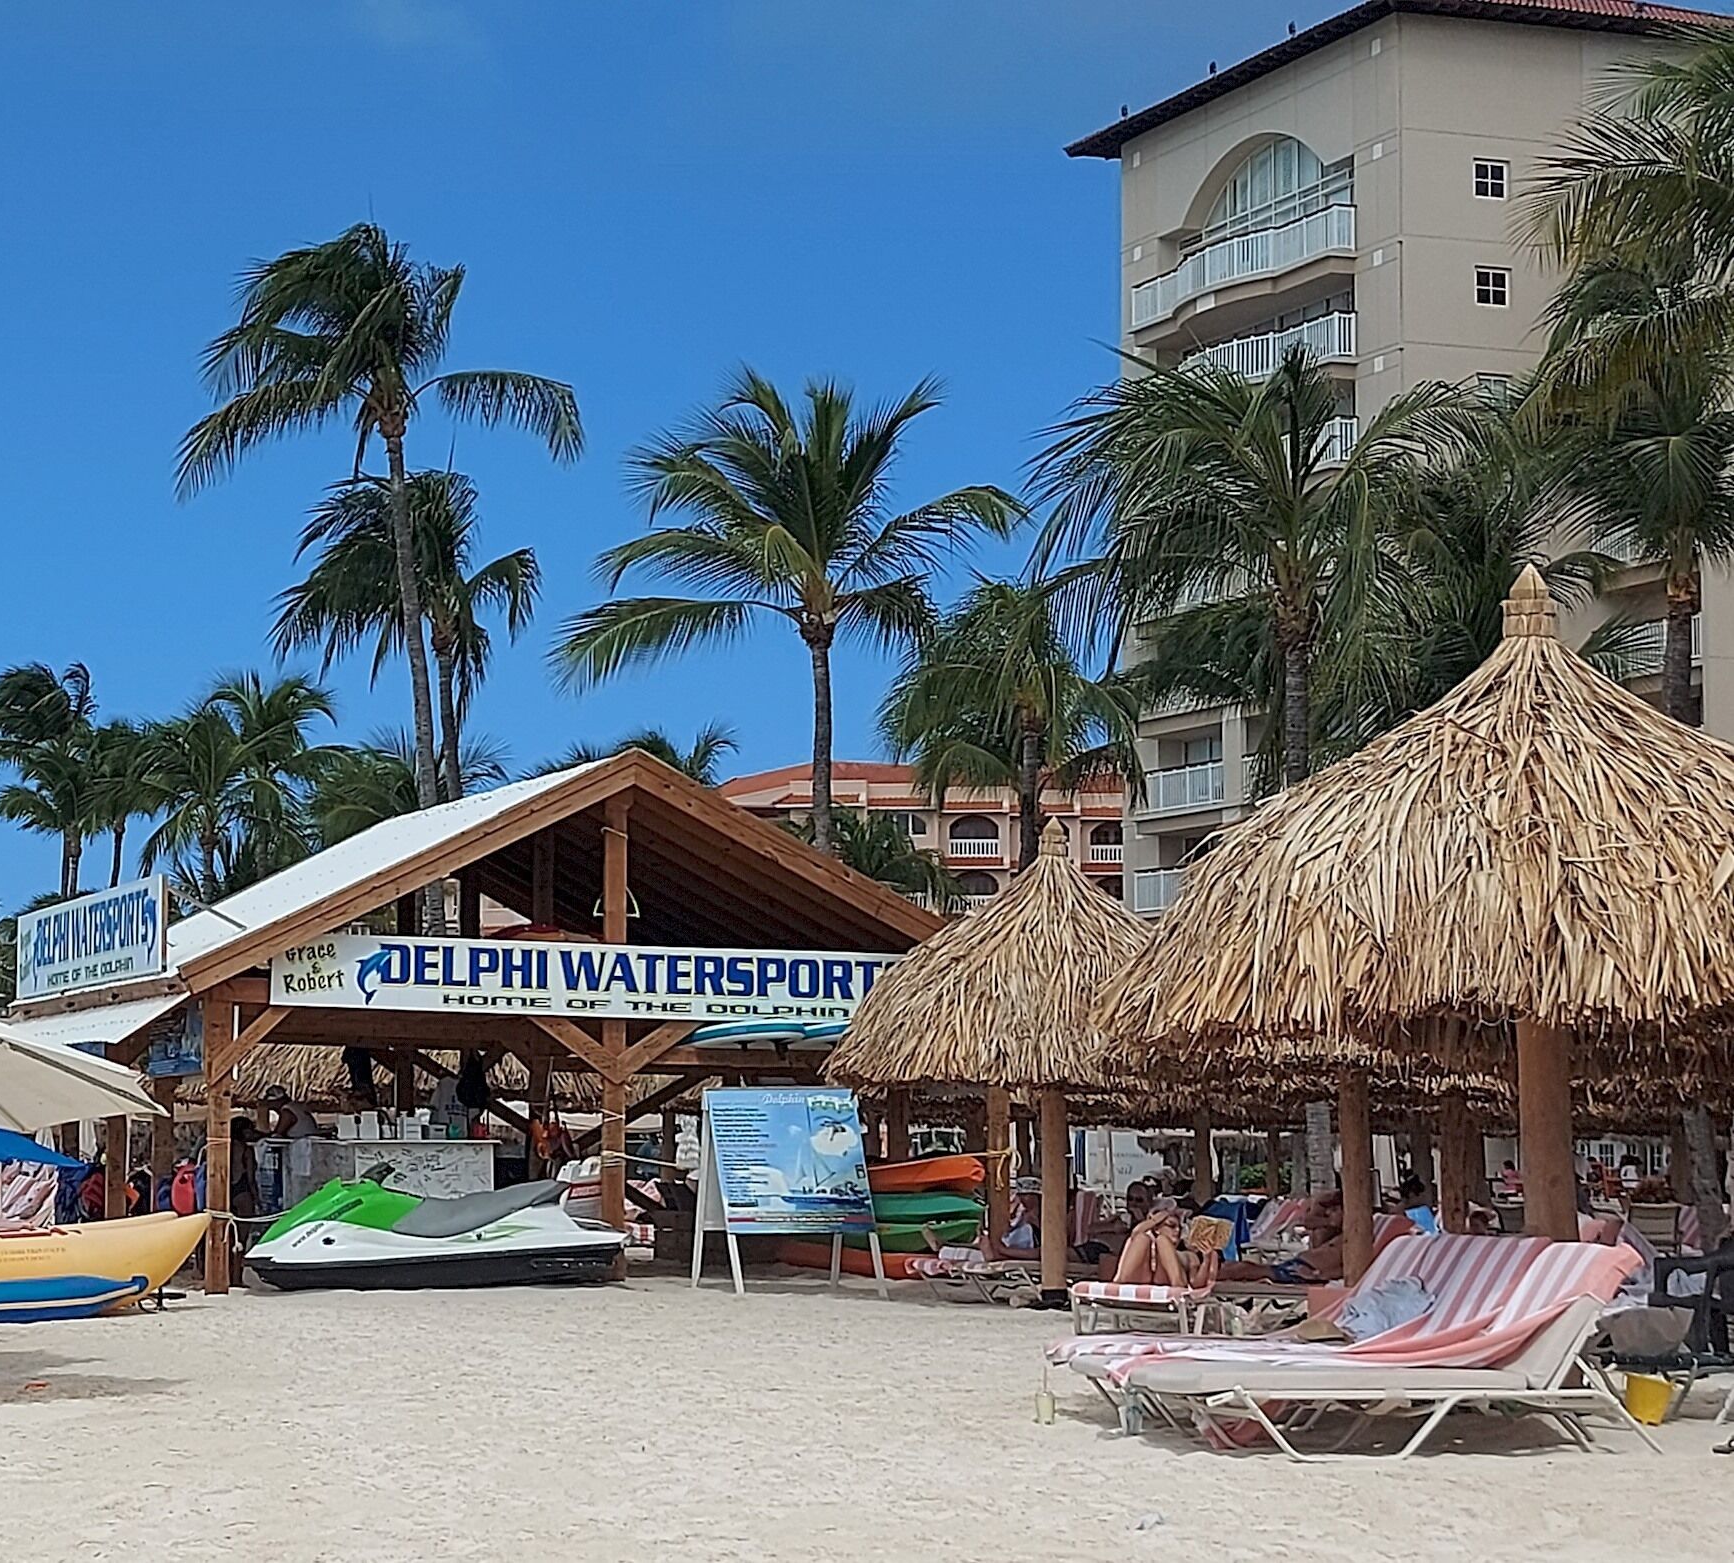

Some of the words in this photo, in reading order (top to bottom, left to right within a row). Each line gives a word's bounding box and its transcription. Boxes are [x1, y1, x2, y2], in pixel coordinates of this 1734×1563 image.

[36, 911, 69, 967] DELPHI
[72, 888, 149, 960] WATERSPORTS
[285, 943, 336, 962] Grace
[47, 971, 69, 987] HOME
[72, 968, 82, 981] OF
[85, 964, 98, 979] THE
[101, 957, 134, 978] DOLPHIN
[283, 969, 344, 993] Robert
[379, 943, 551, 990] DELPHI
[559, 950, 896, 1000] WATERSPORT
[443, 994, 552, 1009] HOME
[566, 999, 611, 1010] OF
[625, 1001, 692, 1014] THE
[706, 1004, 850, 1018] DOLPHIN
